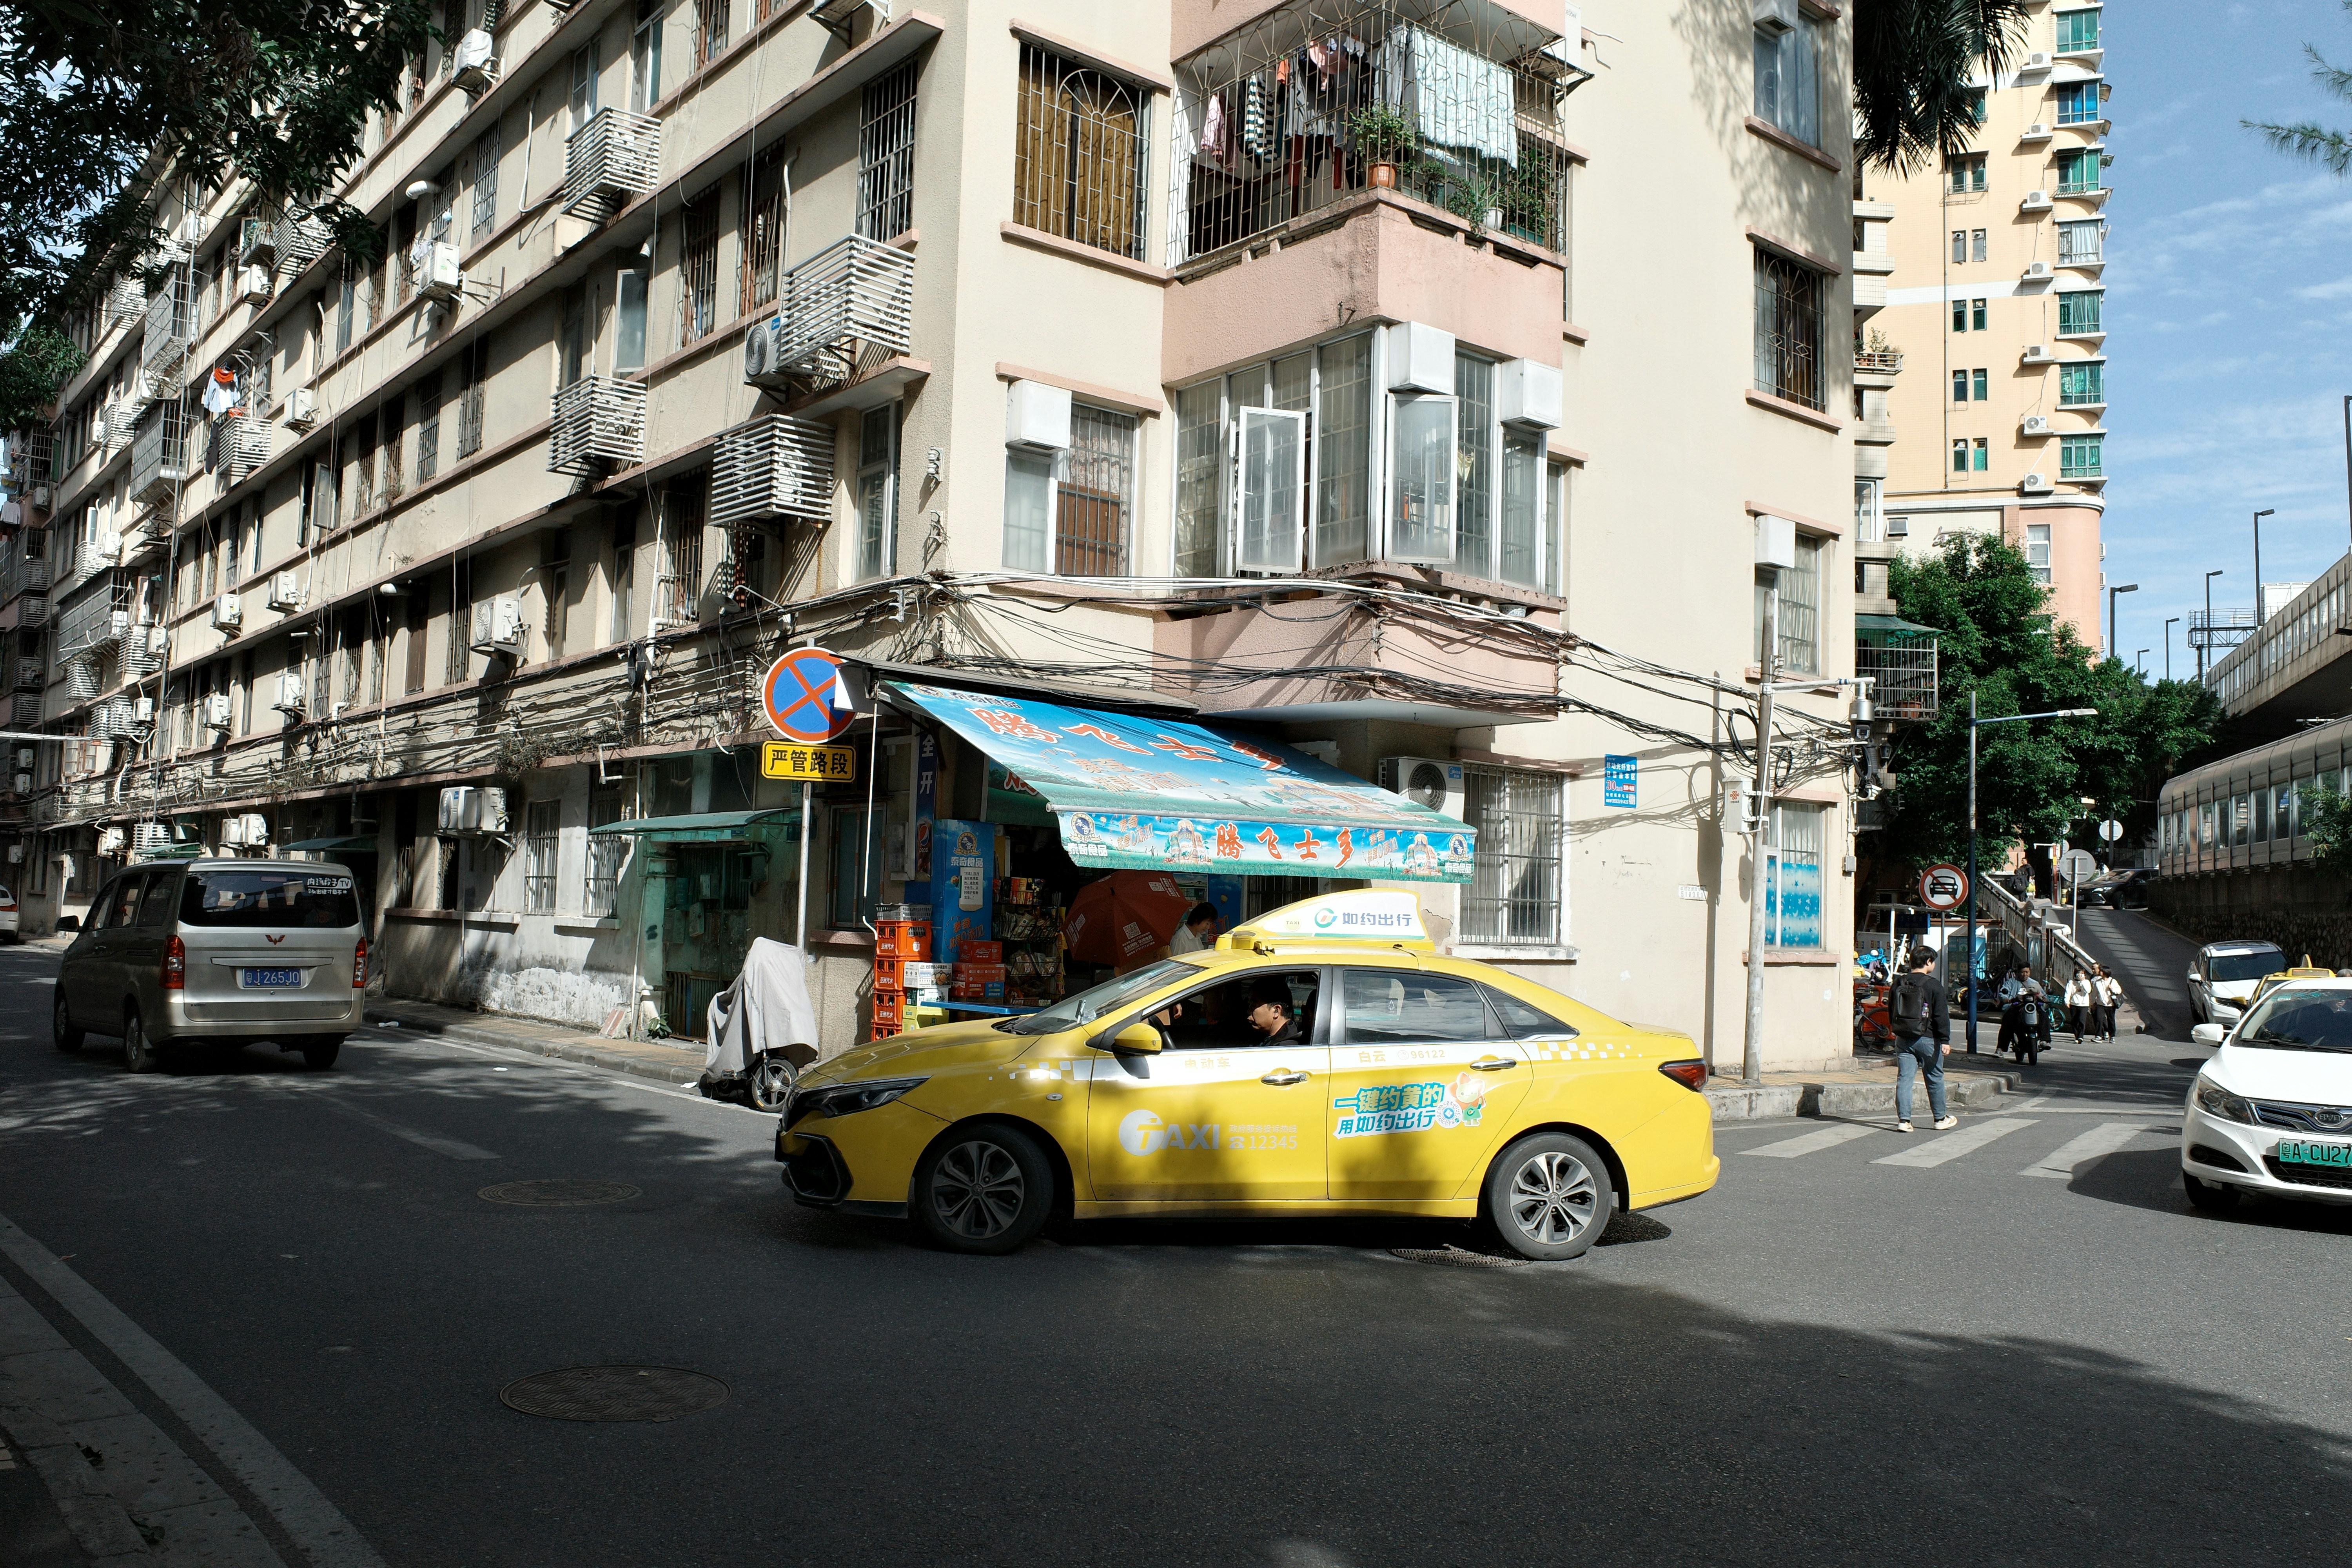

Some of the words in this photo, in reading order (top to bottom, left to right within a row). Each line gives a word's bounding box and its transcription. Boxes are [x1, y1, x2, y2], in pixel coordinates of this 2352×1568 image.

[770, 750, 848, 775] 严管路段
[1067, 843, 1108, 857] 泰奇食品
[1215, 822, 1354, 870] 腾飞士多
[951, 857, 983, 867] 泰奇食品
[1445, 862, 1472, 874] 泰奇食品
[1342, 911, 1412, 927] 如约出行
[1185, 1057, 1231, 1070] 电动车
[1359, 1051, 1386, 1063] 白云
[1410, 1050, 1446, 1059] 96122
[1334, 1083, 1445, 1112] 一键约黄的
[1338, 1109, 1436, 1135] 用如约出行
[2319, 1113, 2340, 1122] BYD
[1133, 1120, 1220, 1151] TAXI
[1229, 1124, 1298, 1134] 政府服务投诉热线
[1249, 1136, 1298, 1150] 12345
